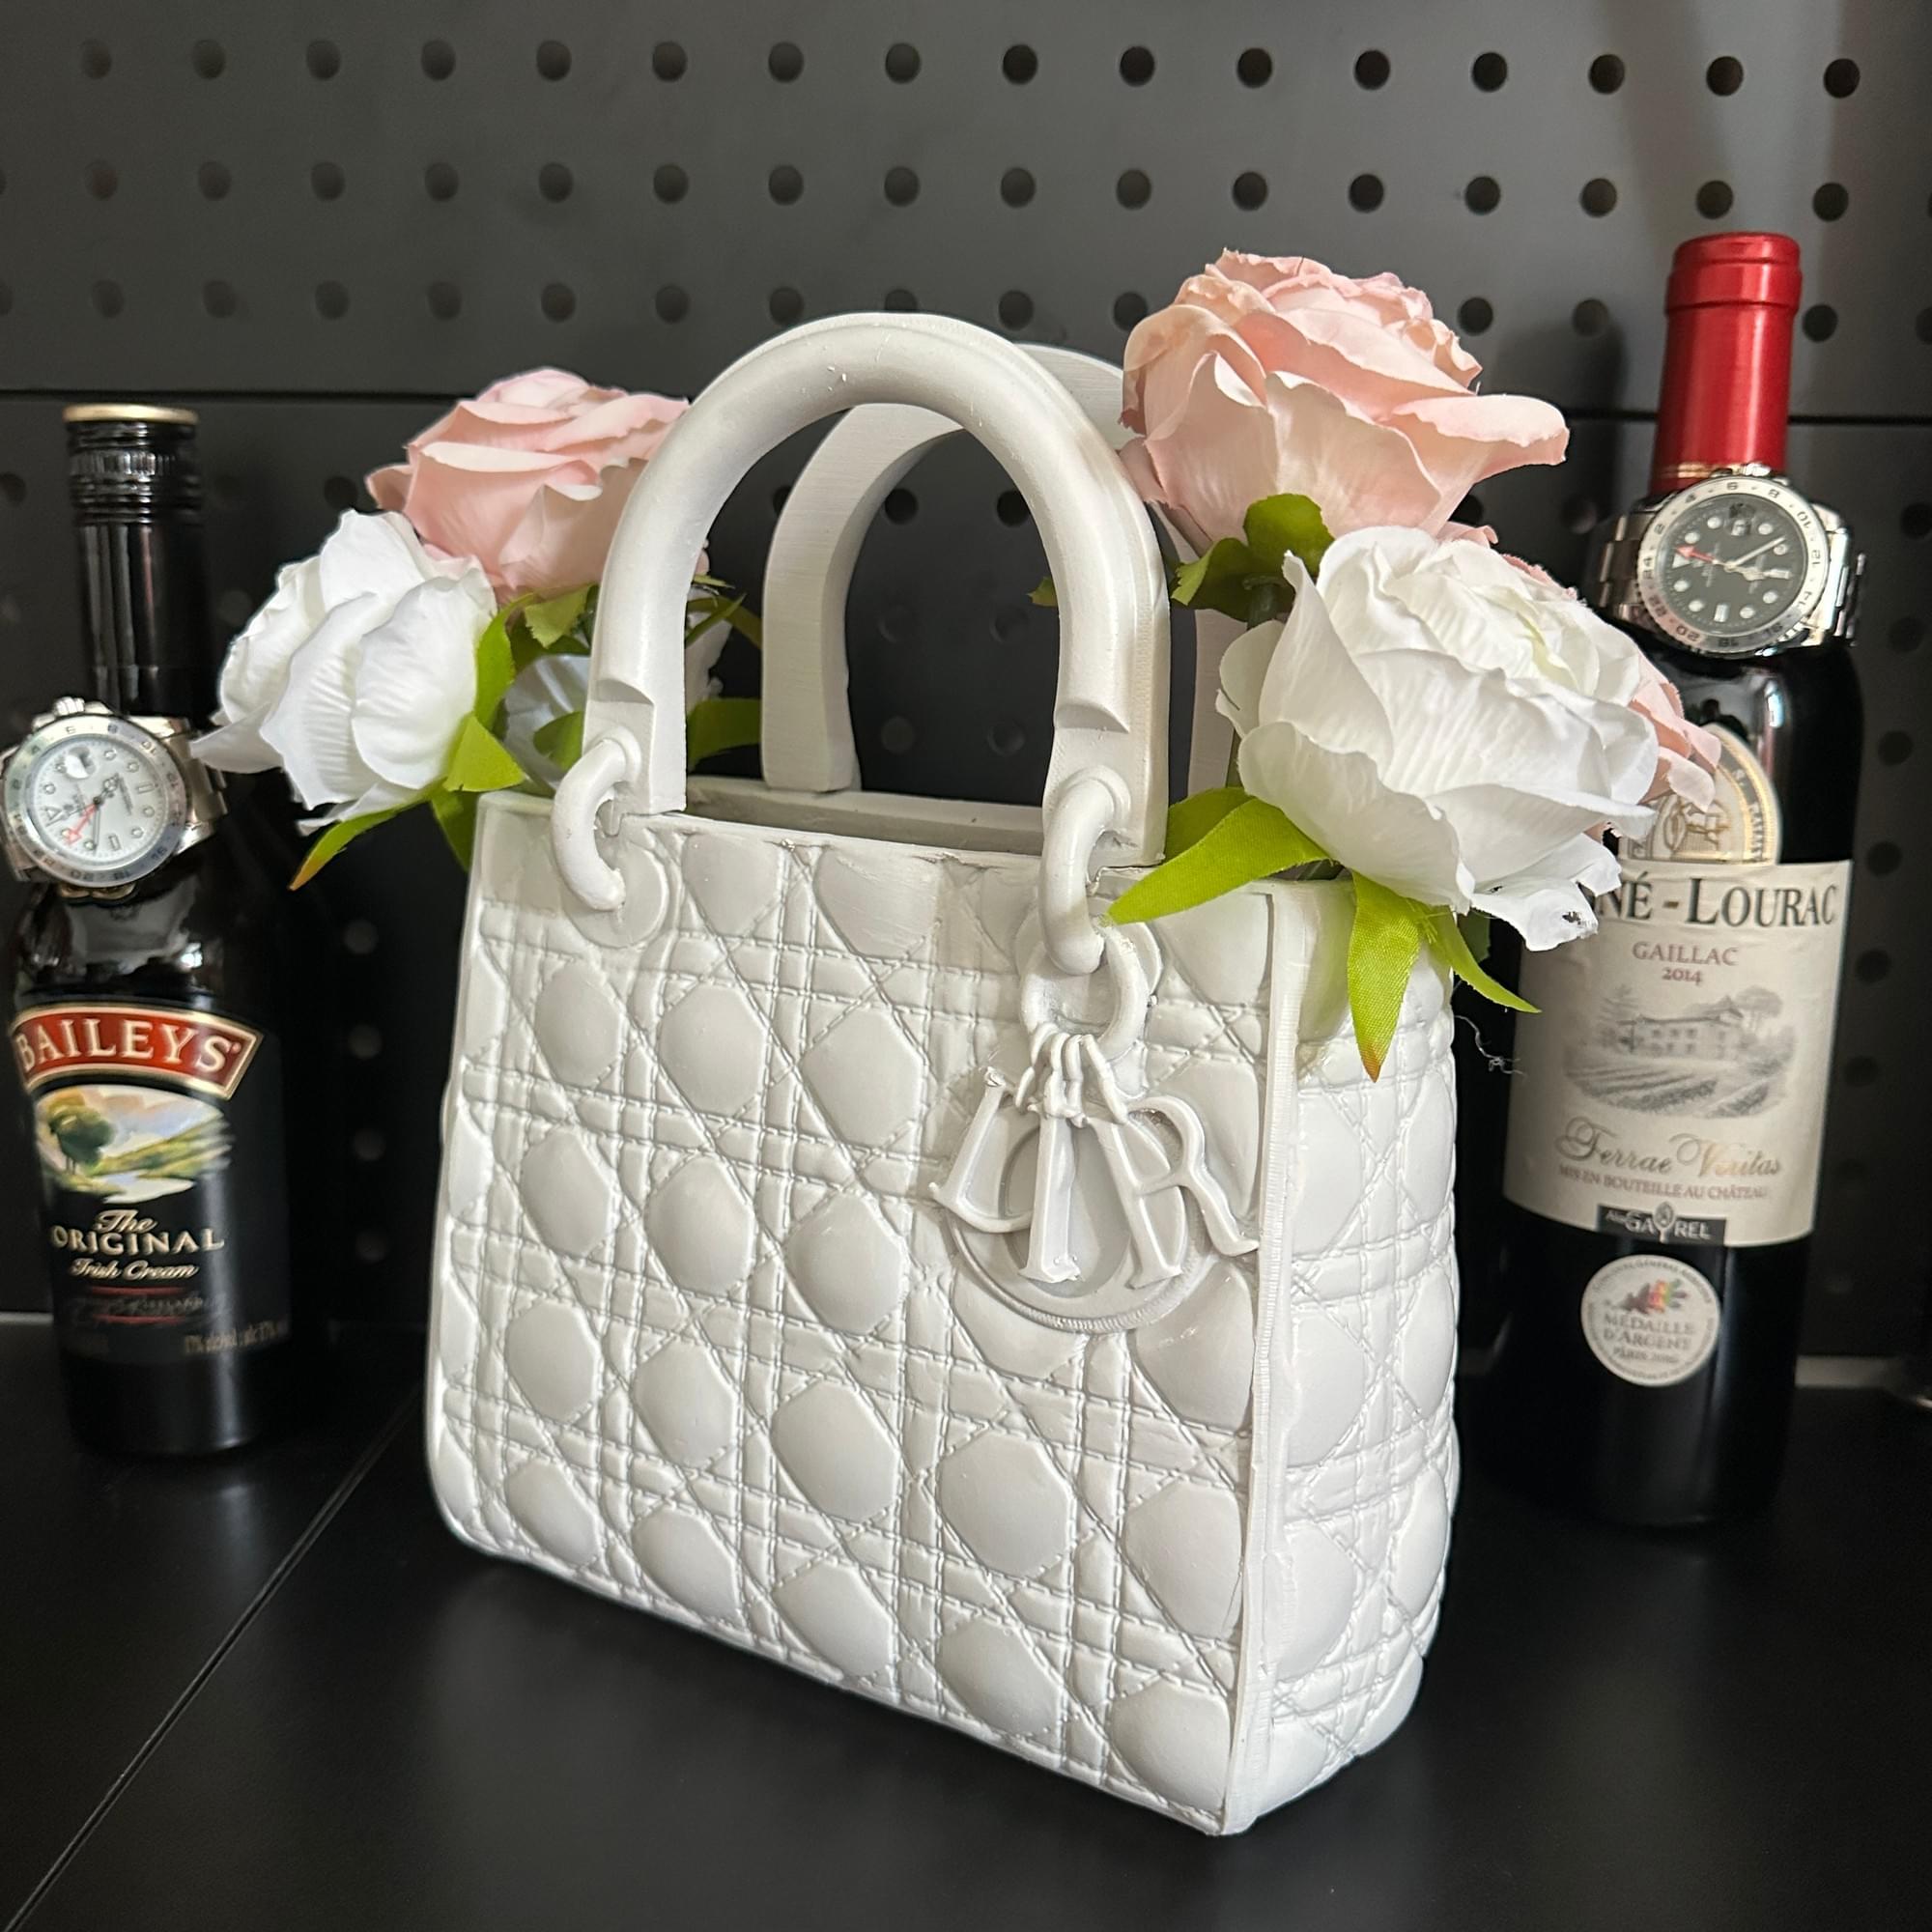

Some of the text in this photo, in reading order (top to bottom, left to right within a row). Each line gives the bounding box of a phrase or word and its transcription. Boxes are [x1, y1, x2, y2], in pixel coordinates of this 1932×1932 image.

[1632, 940, 1741, 967] GAILLAC
[1661, 967, 1704, 986] 2014
[96, 1209, 158, 1235] The
[51, 1226, 226, 1256] ORIGINAL
[70, 1260, 199, 1282] Irish Cream
